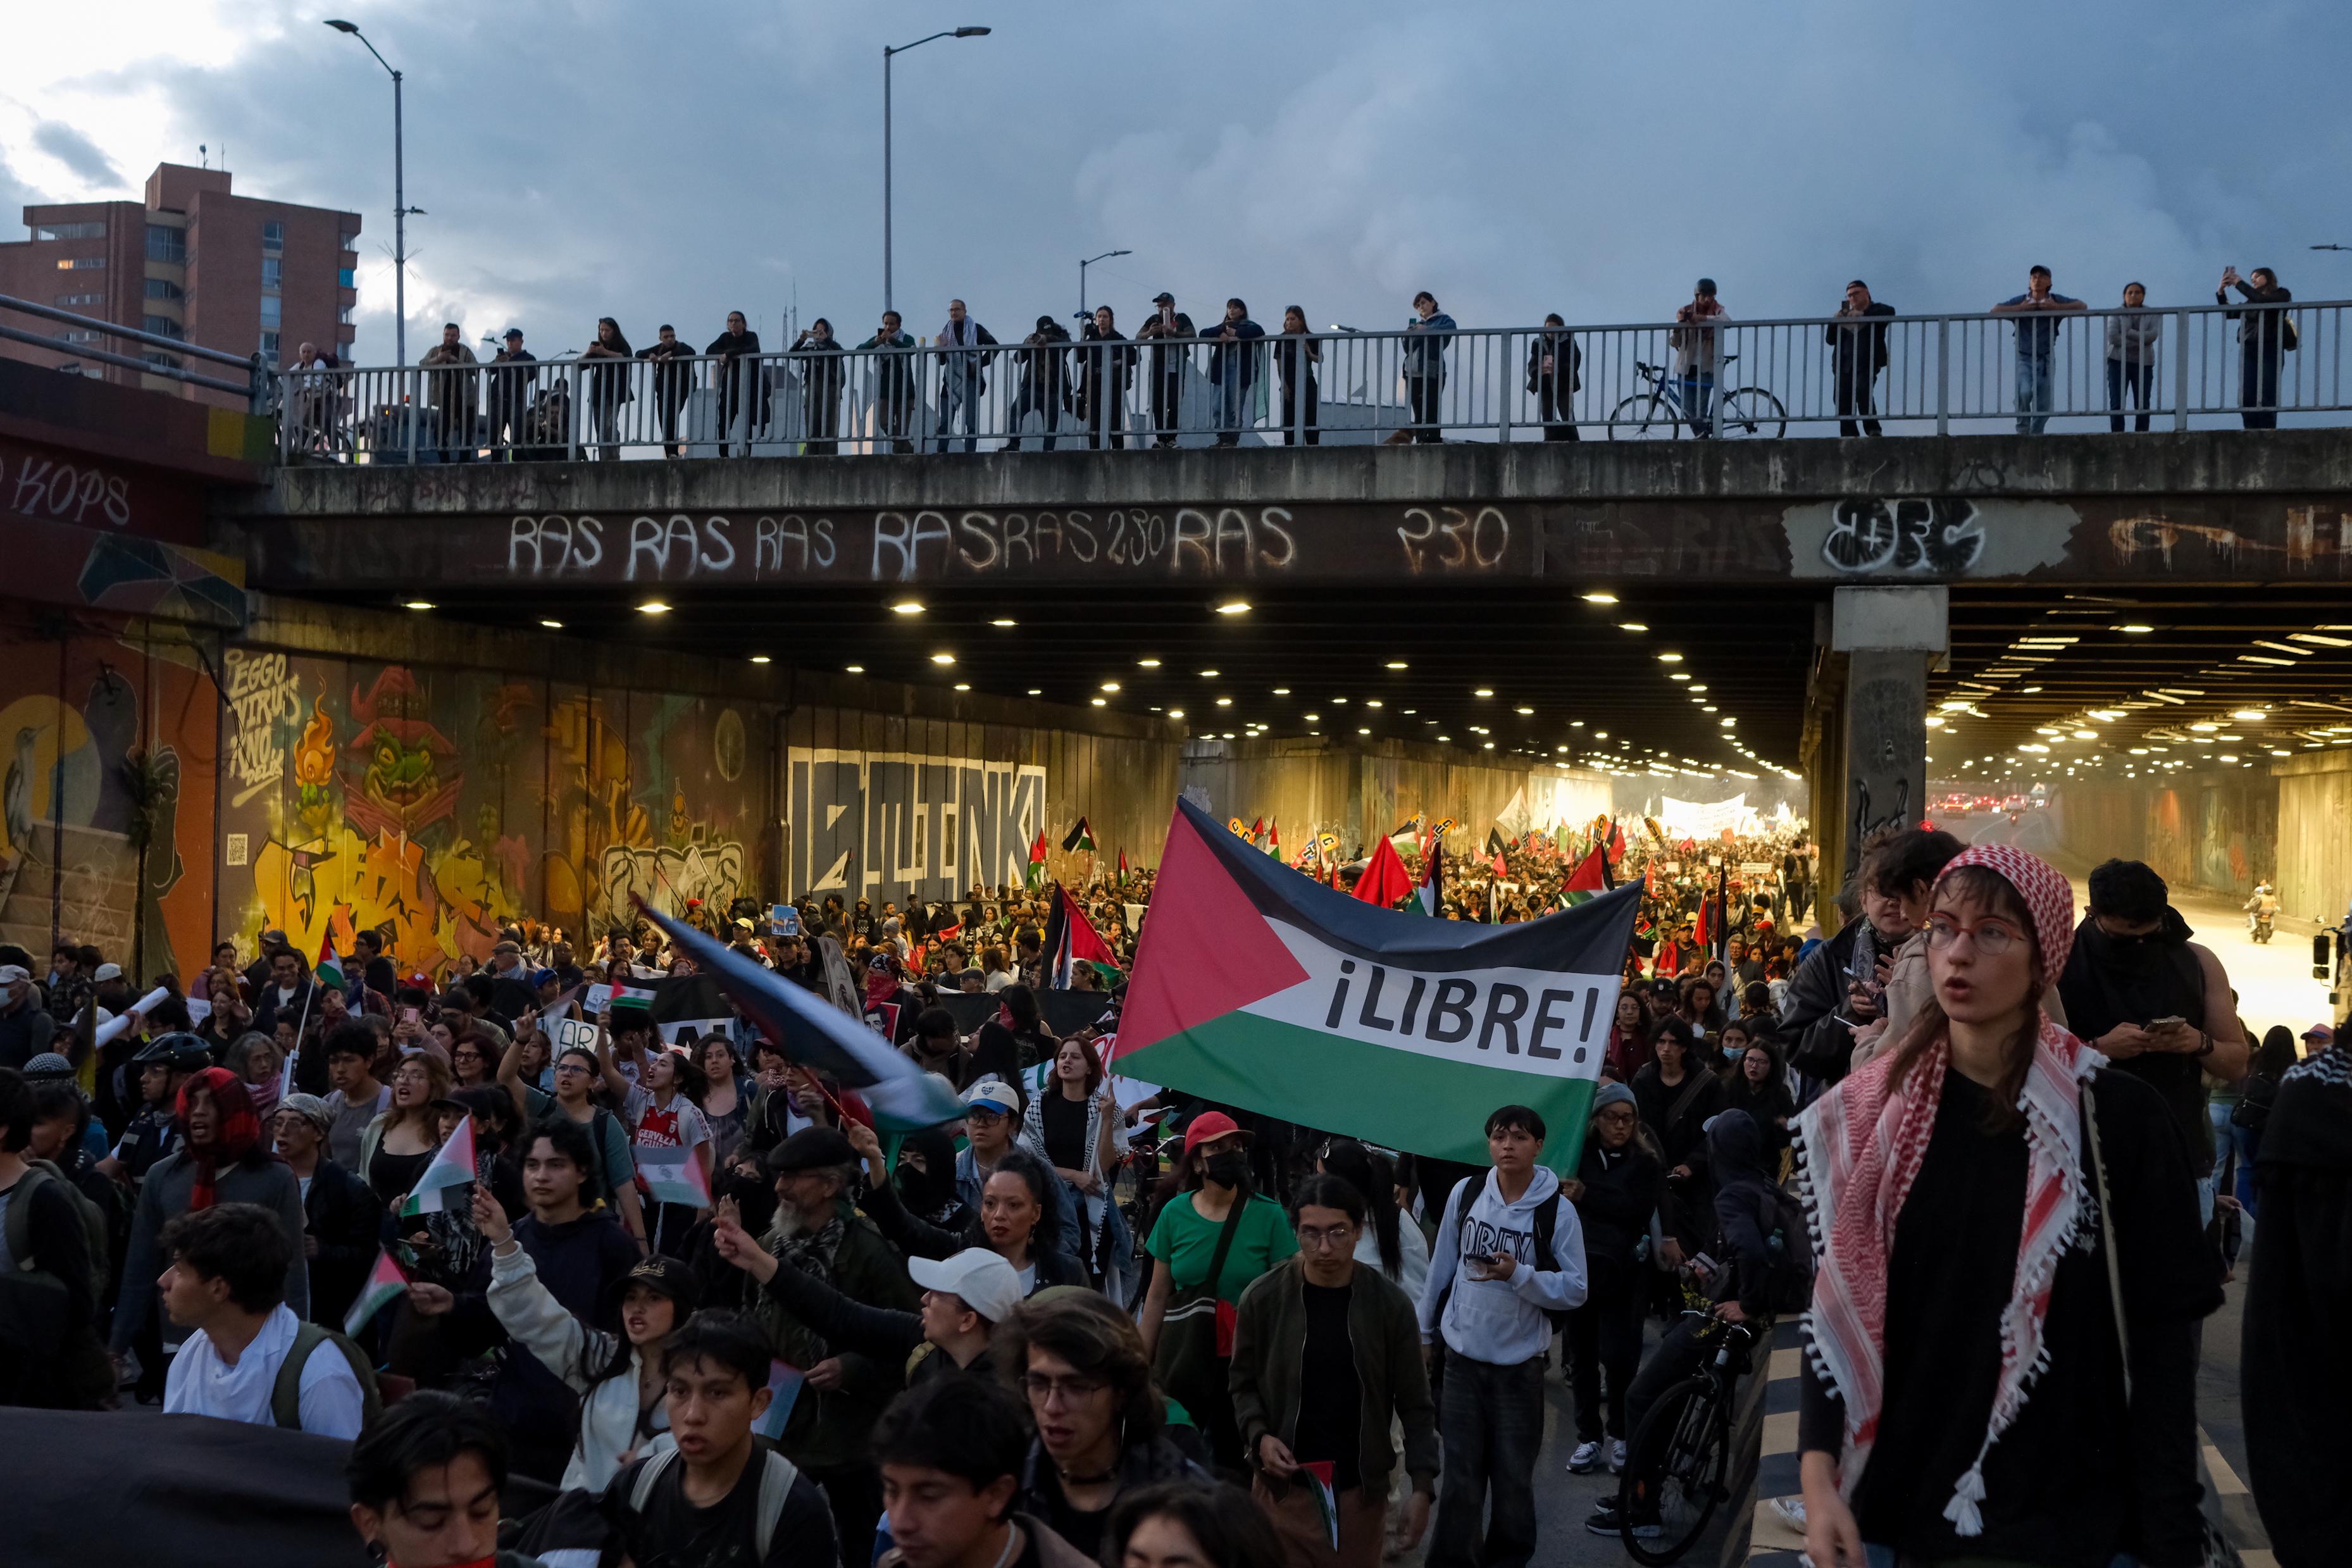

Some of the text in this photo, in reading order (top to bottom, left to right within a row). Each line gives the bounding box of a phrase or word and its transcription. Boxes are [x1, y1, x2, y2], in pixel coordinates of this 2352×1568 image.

[10, 456, 130, 526] KOPS
[509, 514, 603, 571] RAS
[624, 514, 735, 577] RAS
[756, 514, 836, 575] RAS
[873, 511, 997, 579] RAS
[1004, 511, 1098, 569] RAS
[1174, 507, 1296, 573] RAS
[229, 652, 287, 696] EGGO
[1325, 959, 1599, 1063] ¡LIBRE!
[1463, 1216, 1533, 1266] OBEY
